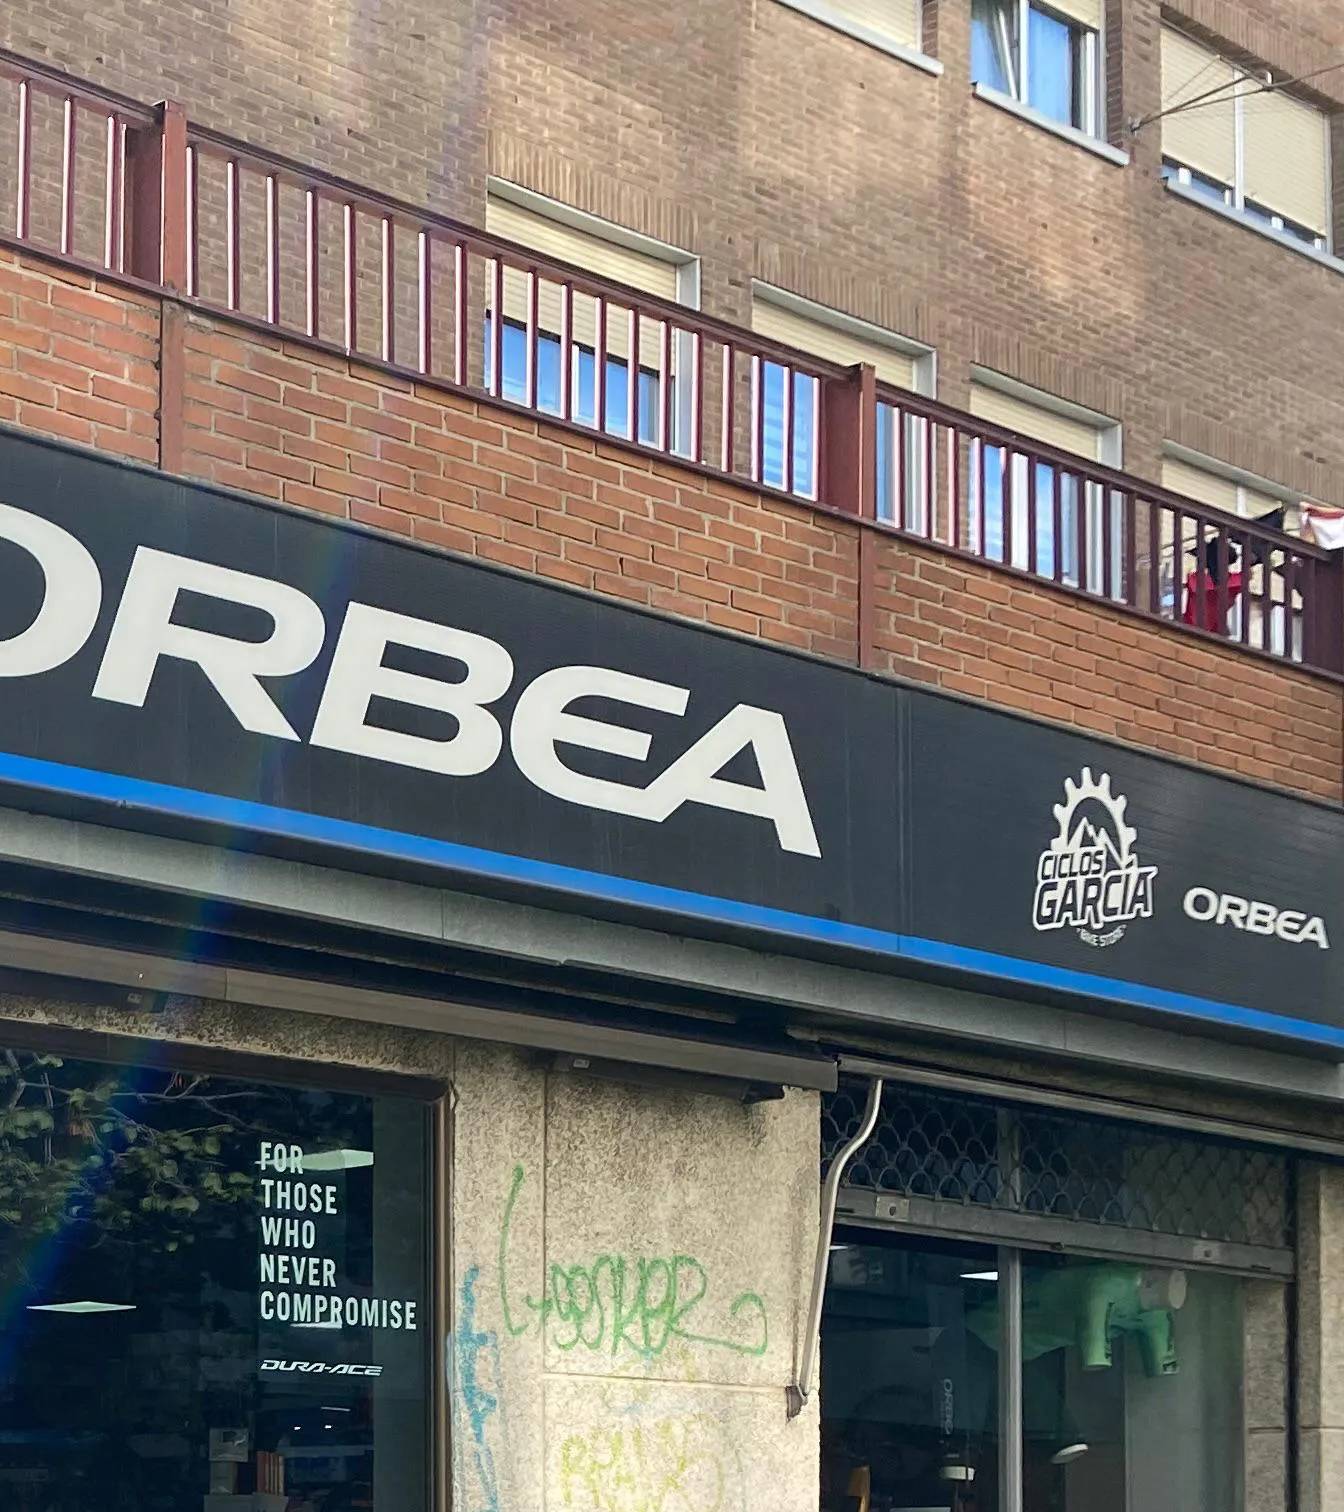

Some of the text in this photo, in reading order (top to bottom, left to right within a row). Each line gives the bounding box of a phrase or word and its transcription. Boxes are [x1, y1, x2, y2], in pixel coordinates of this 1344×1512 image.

[1040, 850, 1104, 881] CICLOS
[1034, 859, 1155, 929] GARCÍA
[1183, 886, 1331, 950] ORBEA
[260, 1142, 304, 1173] FOR
[260, 1179, 338, 1215] THOSE
[260, 1217, 315, 1249] WHO
[260, 1255, 337, 1287] NEVER
[260, 1292, 417, 1330] COMPROMISE
[261, 1360, 383, 1376] DURA-ACE
